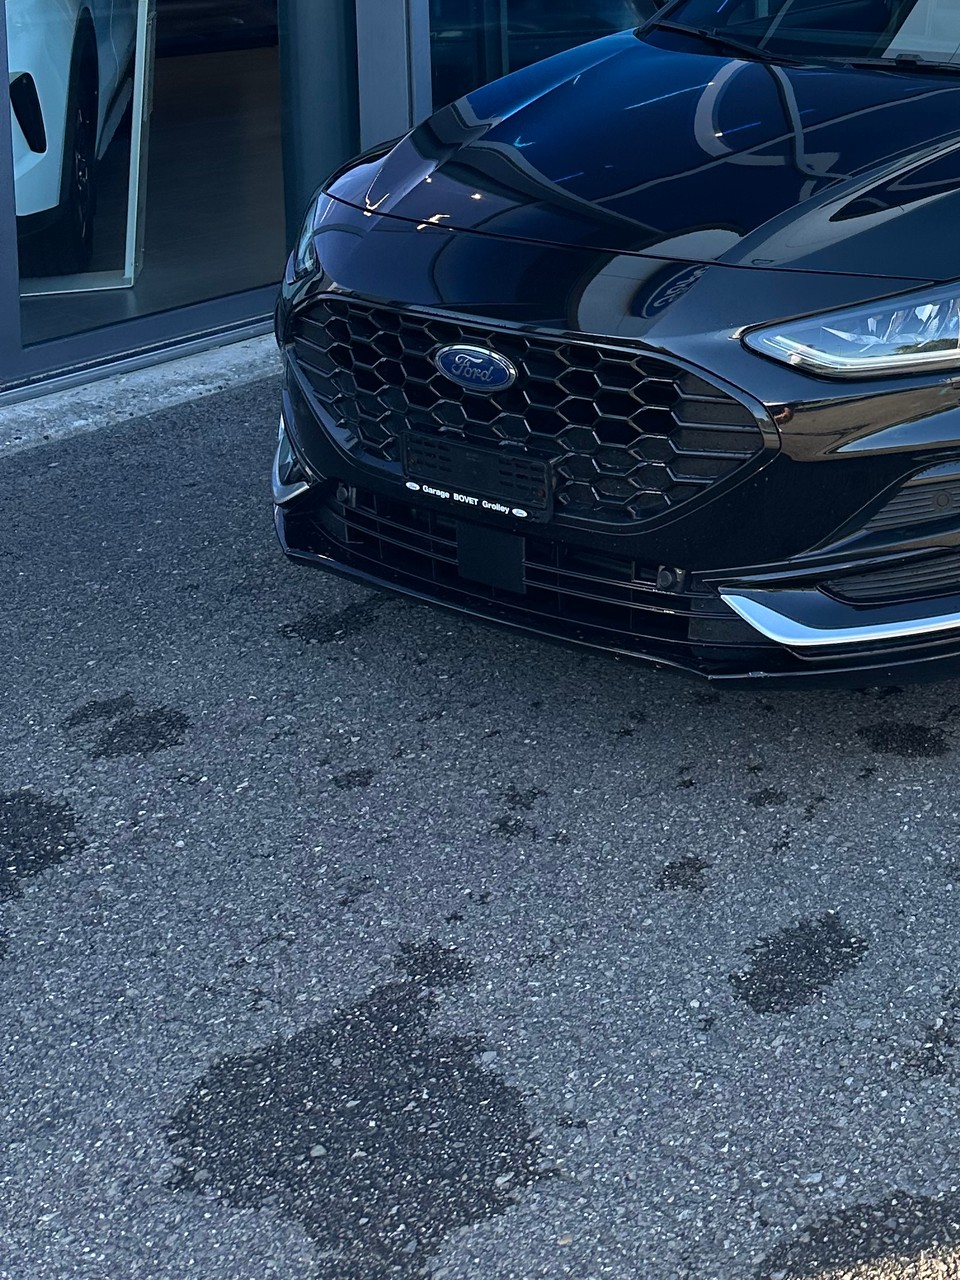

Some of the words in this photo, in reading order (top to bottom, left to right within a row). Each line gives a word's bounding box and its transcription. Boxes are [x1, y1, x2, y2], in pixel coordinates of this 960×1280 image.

[451, 353, 495, 382] Ford
[422, 484, 450, 499] Garage
[453, 492, 479, 505] BOVET
[482, 500, 510, 515] Grolley
